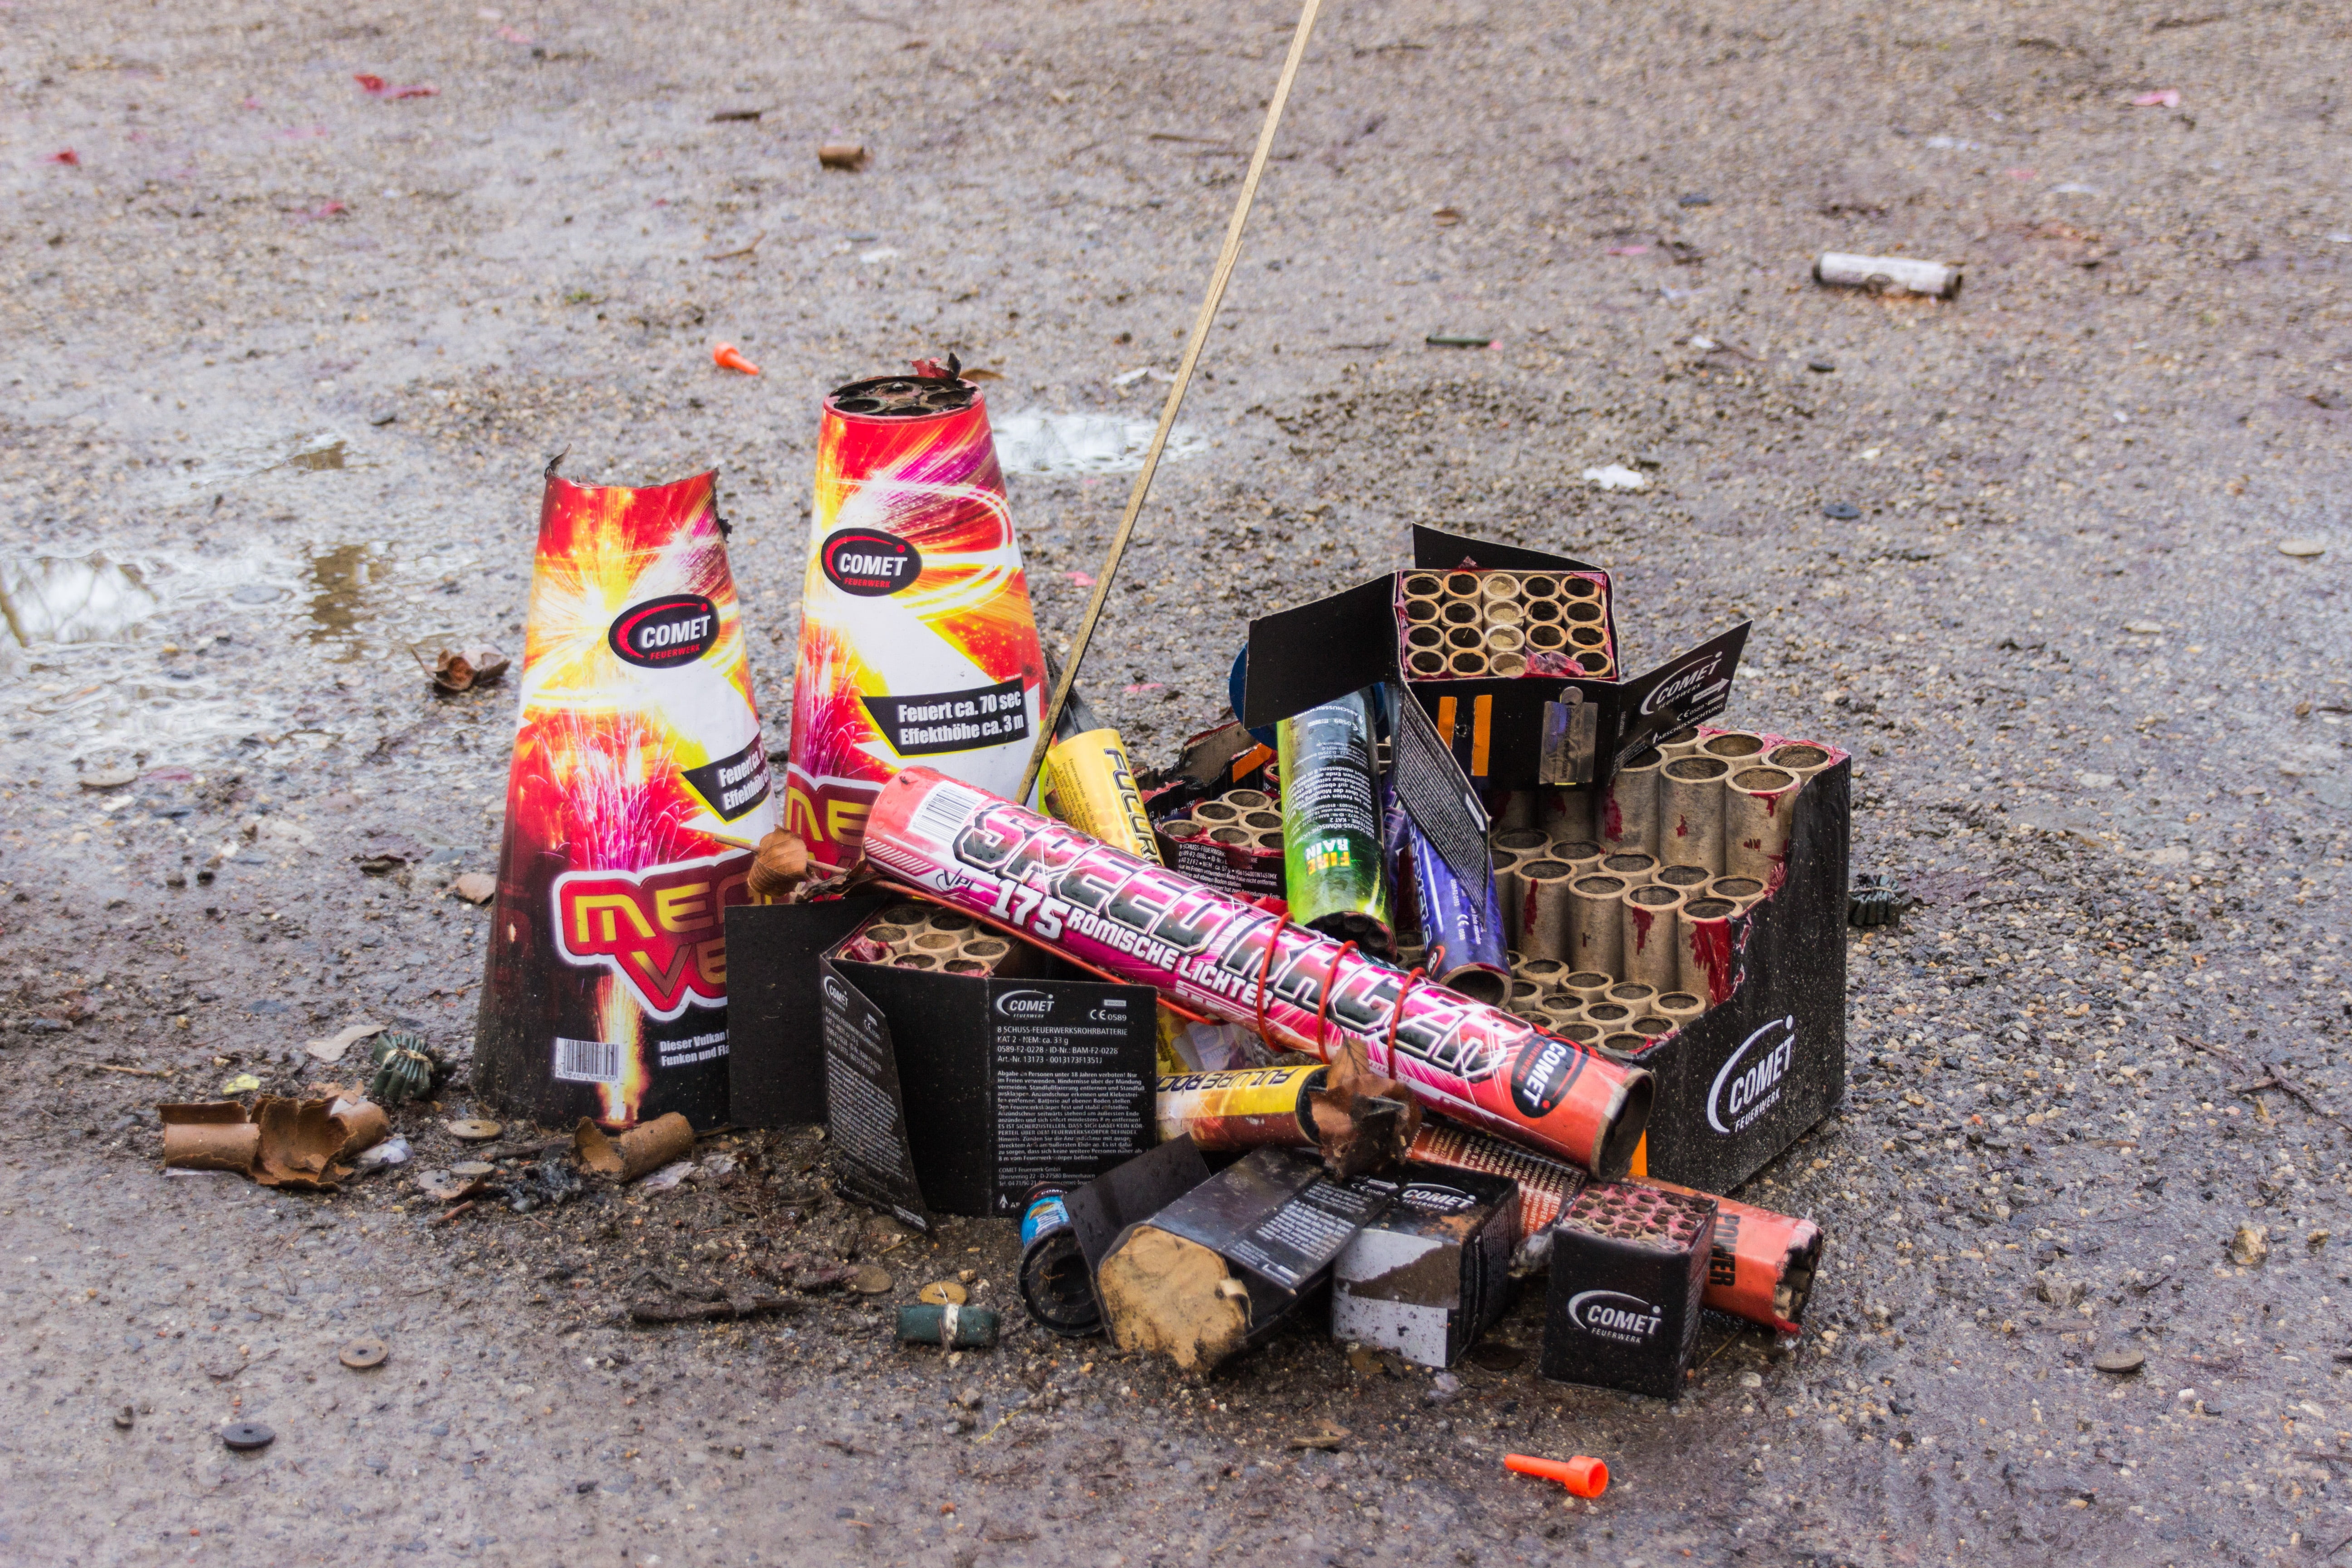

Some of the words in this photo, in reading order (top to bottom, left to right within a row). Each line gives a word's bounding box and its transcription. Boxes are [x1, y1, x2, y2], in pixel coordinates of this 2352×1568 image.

[839, 552, 908, 577] COMET
[844, 577, 891, 588] FEUERWERK
[642, 614, 711, 649] COMET
[650, 644, 701, 661] FEUERWERK
[1656, 658, 1721, 705] COMET
[1658, 682, 1702, 710] FEUERWERK
[898, 702, 953, 723] Feuert
[955, 701, 979, 717] ca.
[980, 694, 997, 714] 70
[999, 691, 1021, 710] sec
[1690, 705, 1704, 715] 0589
[901, 723, 980, 745] Effekthöhe
[982, 720, 1002, 736] ca.
[1003, 715, 1013, 732] 3
[1014, 714, 1024, 730] m
[1658, 703, 1723, 741] ABSCHUSSRICHTUNG
[719, 756, 751, 788] Feuert
[751, 750, 760, 771] ca.
[1063, 762, 1074, 790] Hindernisse
[1069, 758, 1087, 799] Feuerwerksrohr
[1355, 770, 1370, 781] sofort
[723, 771, 764, 810] Effekthöhe
[1297, 773, 1324, 787] anzünden
[1305, 777, 1331, 789] seitwärts
[1333, 777, 1370, 793] Anzündschnur
[1296, 789, 1313, 800] Boden
[1305, 789, 1332, 799] Mündung
[1351, 784, 1371, 799] Batterie
[1363, 802, 1372, 810] Nur
[1352, 818, 1374, 833] BATTERIE
[1366, 830, 1374, 839] 100
[1306, 838, 1348, 861] RAIN
[1307, 851, 1350, 876] FIRE
[1200, 874, 1214, 883] ebenen
[1227, 879, 1243, 887] stellen.
[1204, 868, 1226, 877] verwenden!
[1257, 878, 1278, 887] entfernen.
[953, 802, 1250, 956] SPEED
[1216, 911, 1534, 1085] RACER
[990, 878, 1072, 939] 175
[1179, 955, 1274, 1009] LICHTER
[829, 985, 848, 1007] COMET
[1009, 1000, 1054, 1012] COMET
[1004, 1027, 1127, 1035] SCHUSS-FEUERWERKSROHRBATTERIE
[660, 1039, 693, 1053] Dieser
[693, 1032, 725, 1047] Vulkan
[662, 1051, 697, 1067] Funken
[699, 1048, 717, 1061] und
[1517, 1039, 1544, 1080] FEUERWERK
[1523, 1042, 1568, 1107] COMET
[1728, 1033, 1795, 1115] COMET
[1735, 1088, 1781, 1133] FEUERWERK
[1478, 1151, 1488, 1166] keine
[1524, 1162, 1533, 1180] sofort
[1401, 1188, 1475, 1210] COMET
[1401, 1198, 1450, 1212] FEUERWERK
[1524, 1189, 1534, 1205] Ende
[1529, 1194, 1540, 1224] seitwärts
[1708, 1213, 1741, 1287] POWER
[1587, 1304, 1661, 1336] COMET
[1591, 1327, 1643, 1345] FEUERWERK
